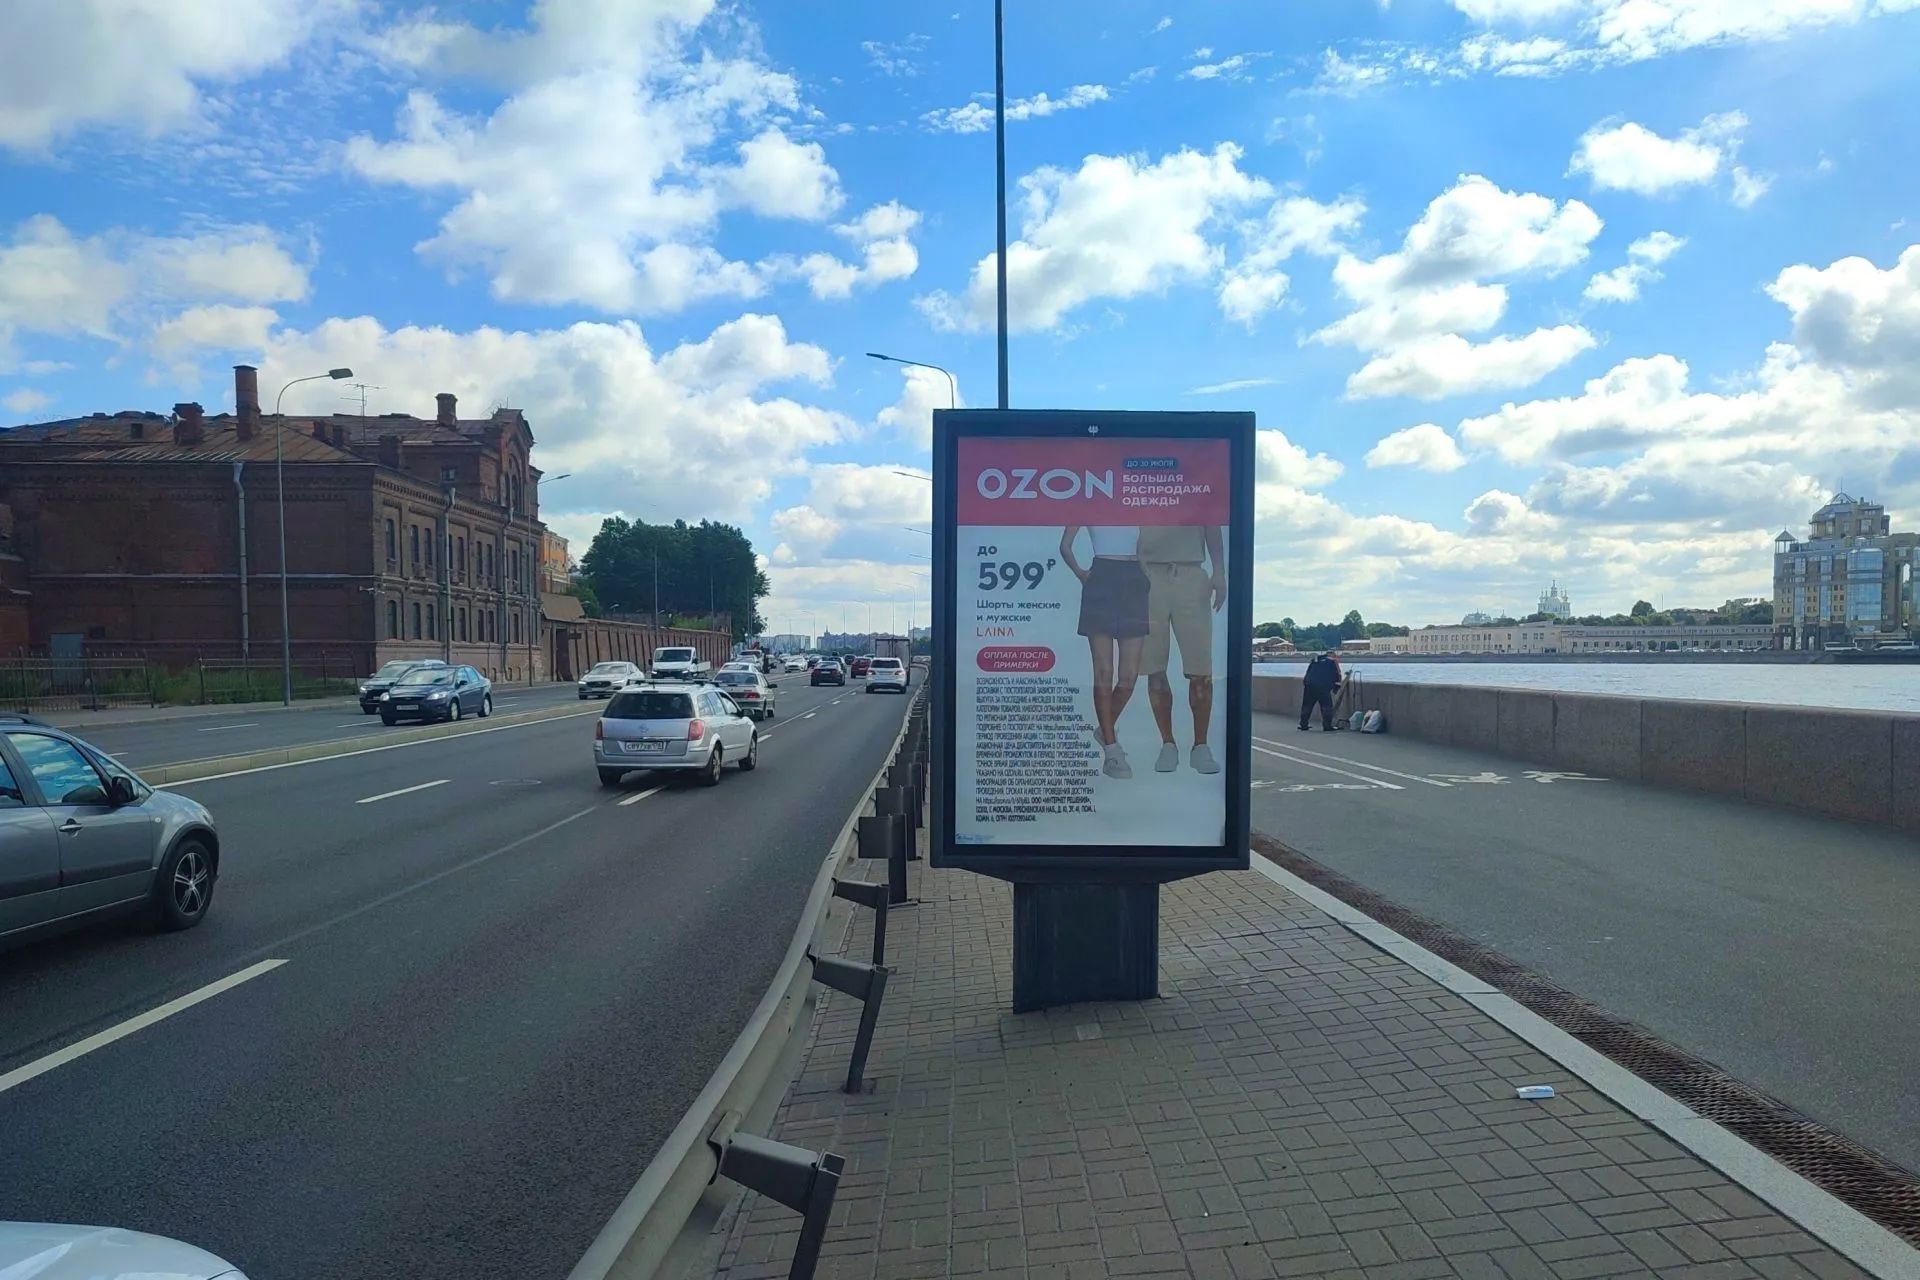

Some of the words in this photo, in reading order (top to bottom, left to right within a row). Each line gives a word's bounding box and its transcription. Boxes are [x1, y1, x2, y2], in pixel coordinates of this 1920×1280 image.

[1126, 460, 1138, 468] ДО
[1122, 474, 1184, 483] БОЛЬШАЯ
[976, 468, 1114, 500] OZON
[1122, 484, 1211, 494] РАСПРОДАЖА
[1122, 496, 1180, 506] ОДЕЖДЫ
[977, 546, 998, 556] до
[976, 600, 1014, 610] Шорты
[1018, 601, 1061, 609] женские
[986, 615, 1032, 623] мужские
[976, 627, 1014, 636] LAINA
